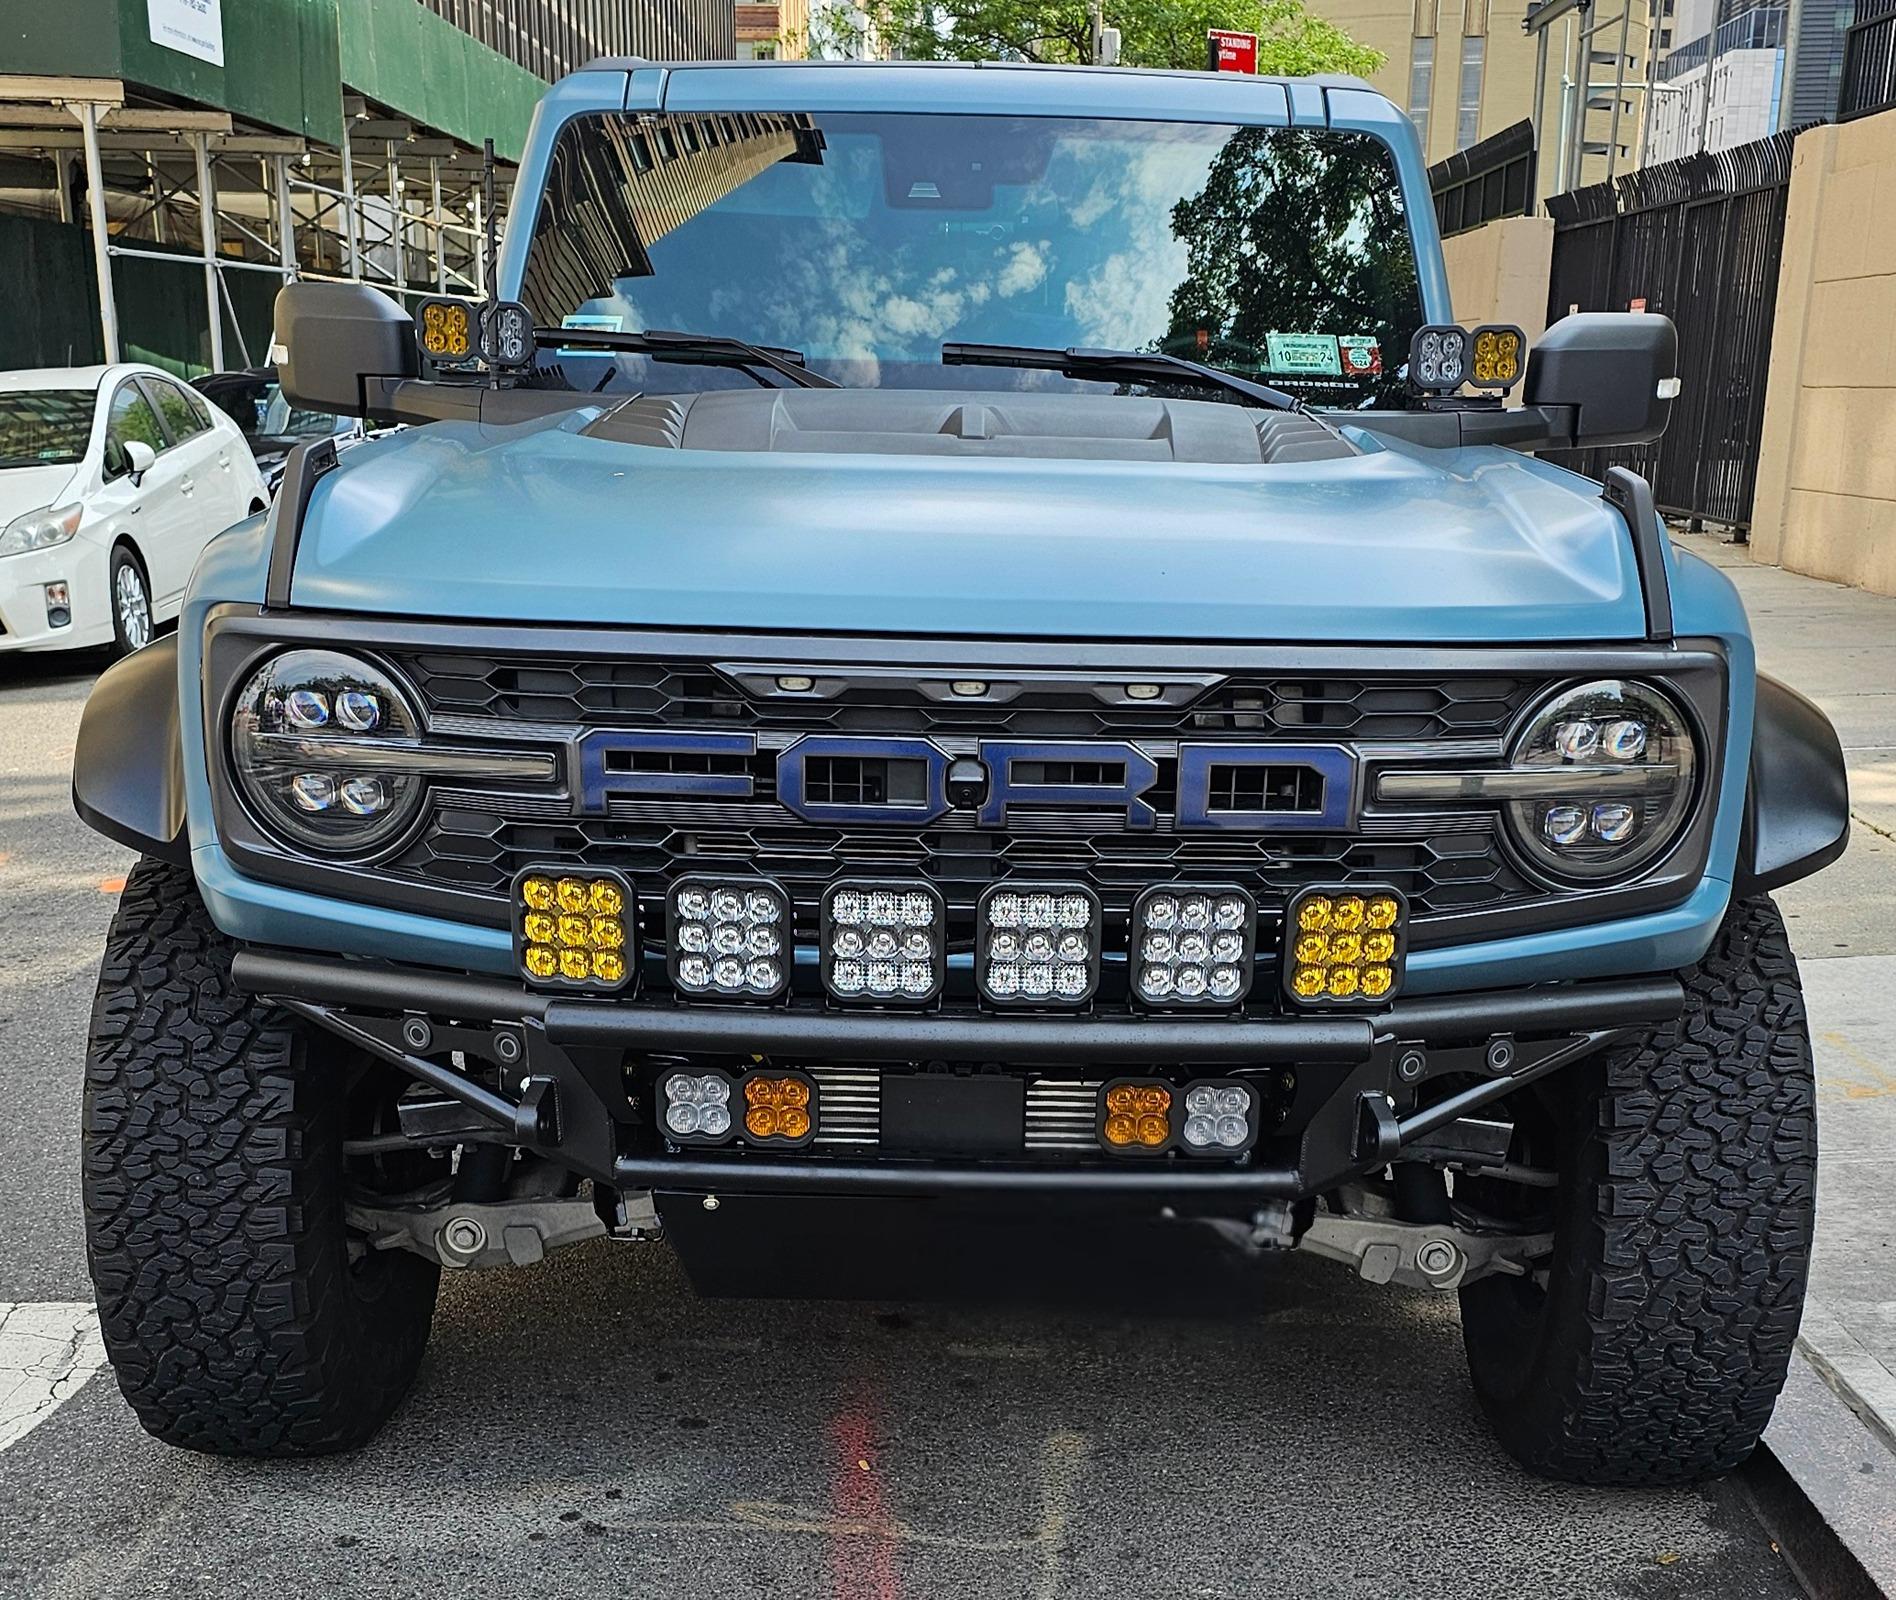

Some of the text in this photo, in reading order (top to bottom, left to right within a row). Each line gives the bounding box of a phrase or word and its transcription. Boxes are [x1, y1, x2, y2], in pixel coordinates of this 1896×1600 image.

[1220, 36, 1251, 50] STANDING
[1218, 49, 1237, 61] ytime
[1278, 350, 1292, 362] 10
[577, 728, 1360, 832] FORD
